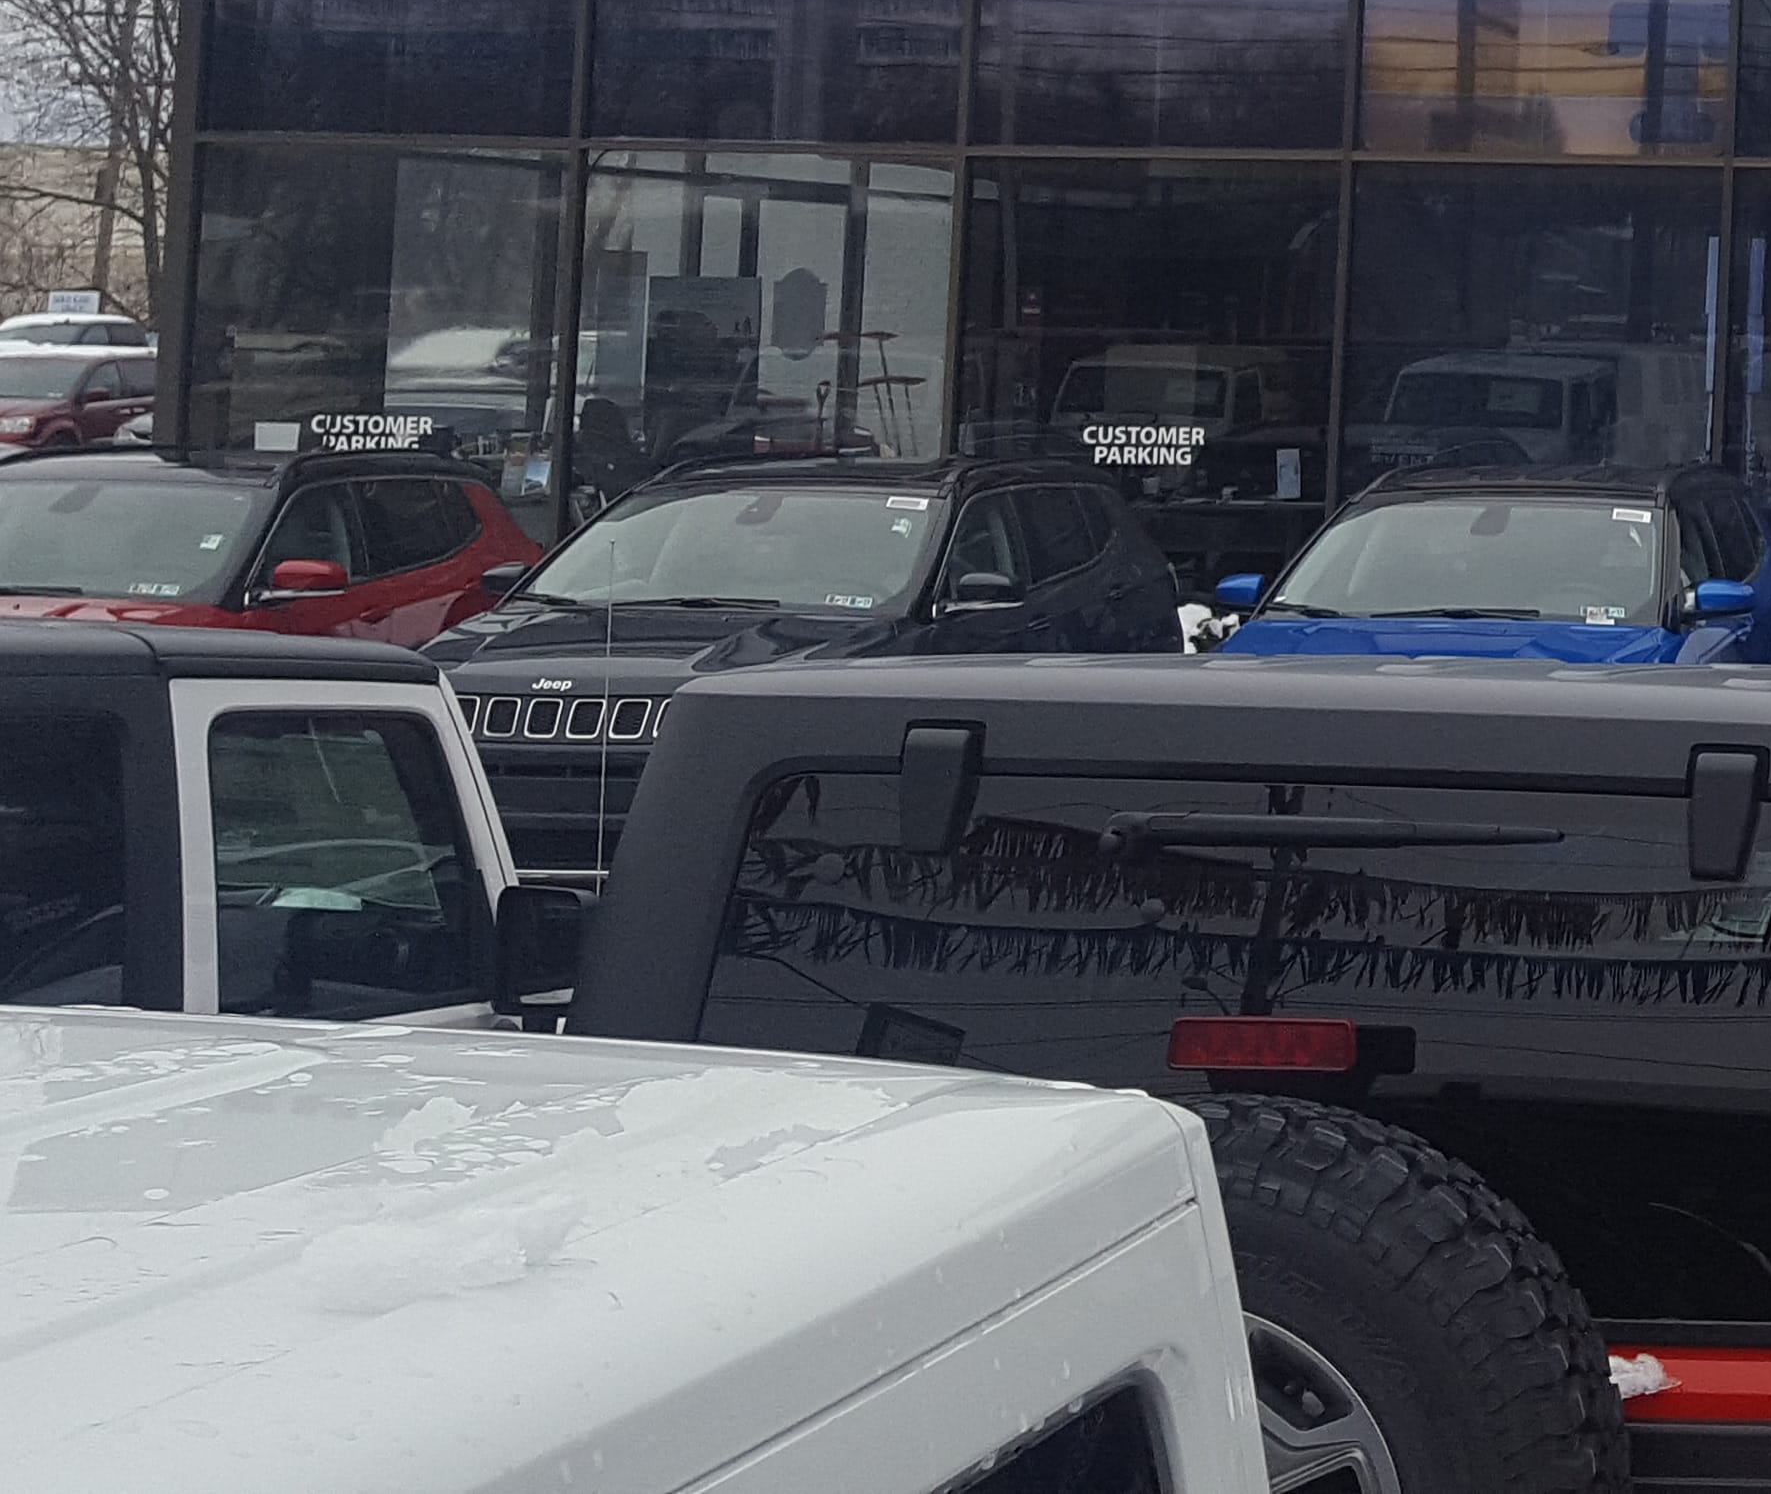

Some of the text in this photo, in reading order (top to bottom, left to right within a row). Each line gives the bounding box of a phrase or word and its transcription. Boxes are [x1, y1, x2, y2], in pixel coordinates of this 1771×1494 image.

[310, 413, 433, 435] CUSTOMER
[1082, 425, 1206, 446] CUSTOMER
[1094, 446, 1193, 466] PARKING
[531, 677, 573, 692] Jeep
